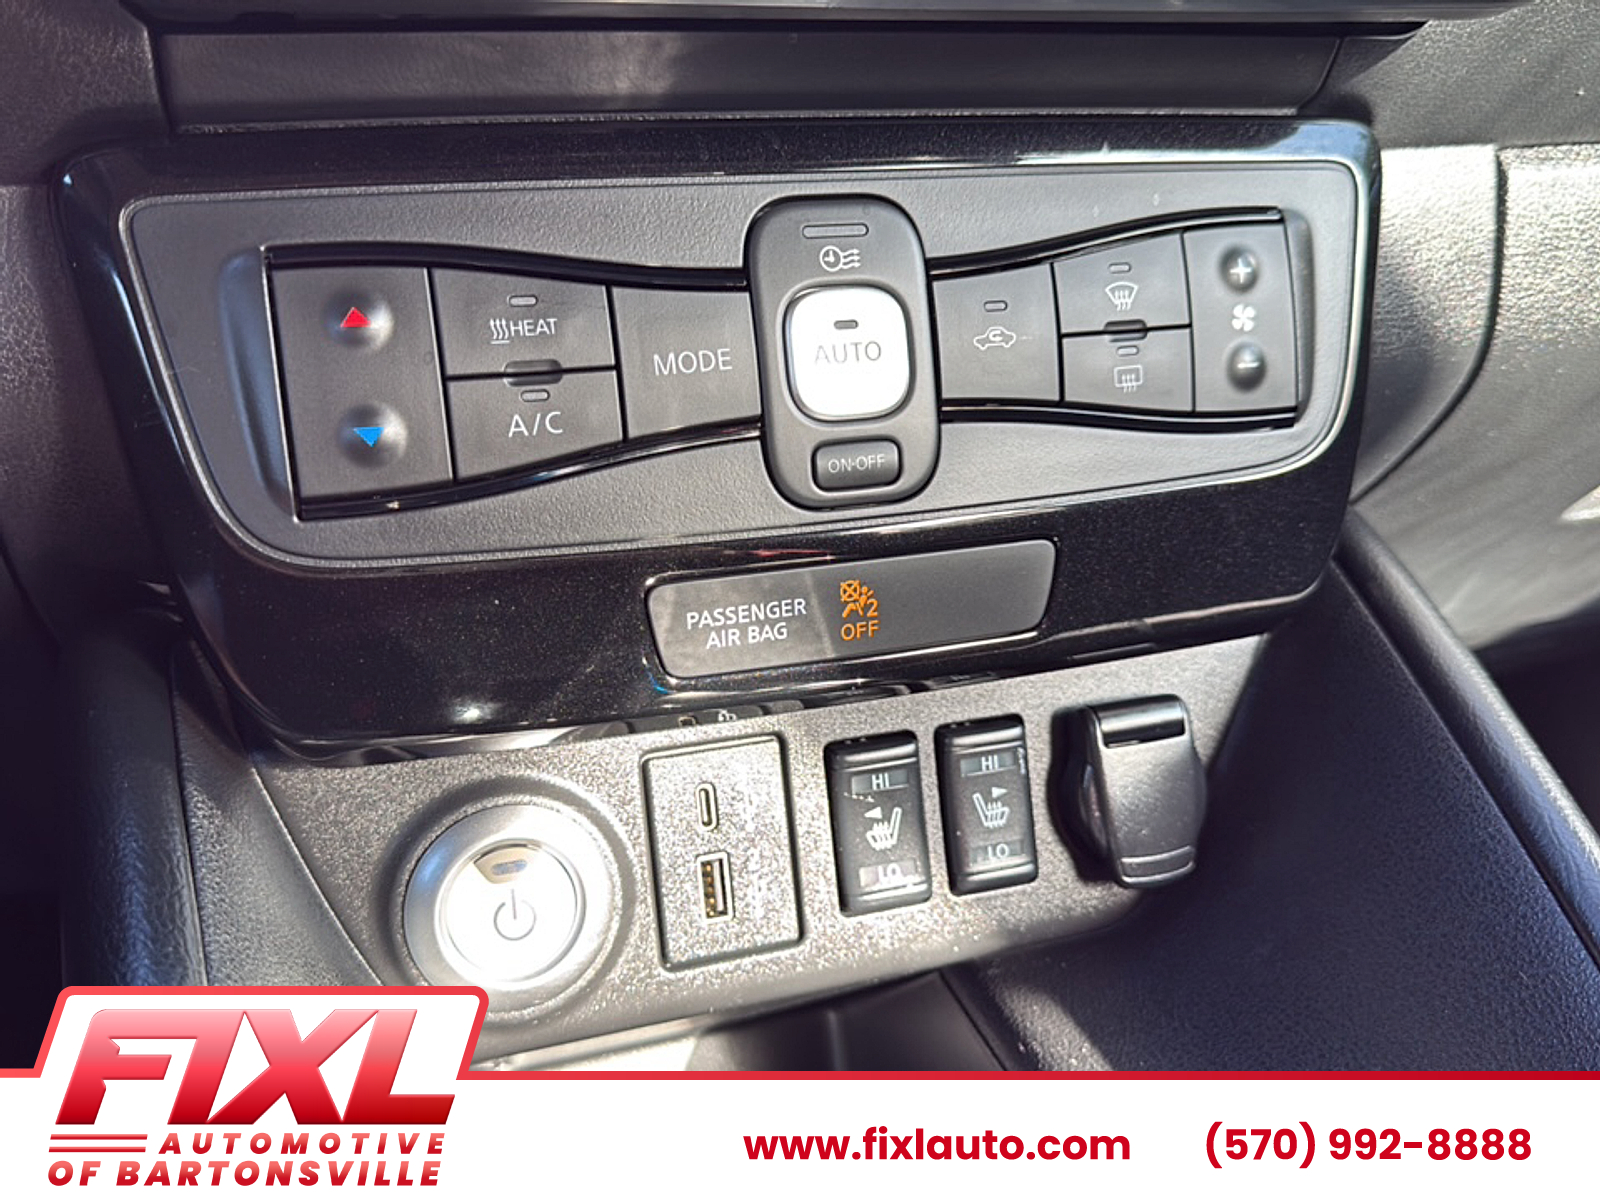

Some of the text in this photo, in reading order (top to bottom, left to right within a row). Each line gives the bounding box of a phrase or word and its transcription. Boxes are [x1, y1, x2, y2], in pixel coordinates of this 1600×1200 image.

[510, 318, 558, 337] HEAT
[653, 348, 732, 376] MODE
[814, 340, 882, 365] AUTO
[508, 411, 563, 437] A/C
[686, 598, 807, 630] PASSENGER
[706, 622, 788, 650] AIR BAG
[840, 619, 880, 641] OFF
[980, 754, 999, 772] HI
[871, 772, 890, 791] HI
[987, 843, 1010, 860] LO
[878, 862, 901, 882] LO
